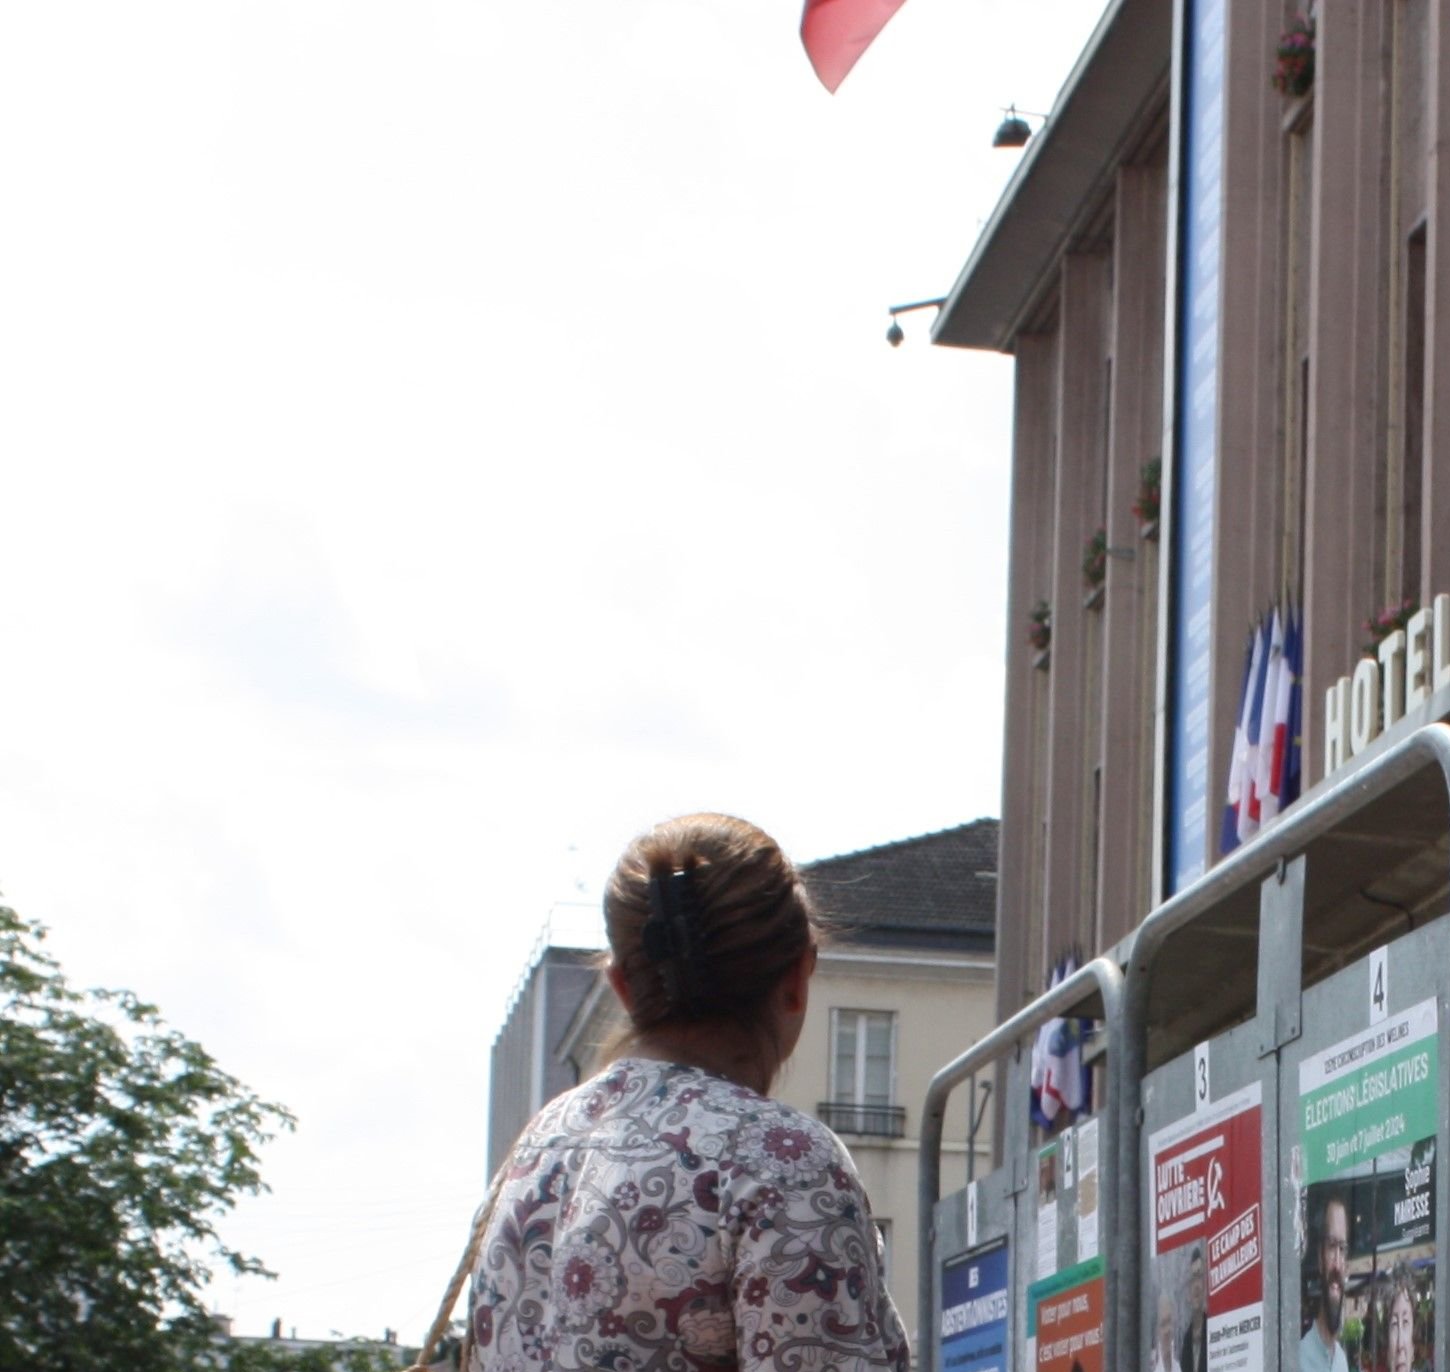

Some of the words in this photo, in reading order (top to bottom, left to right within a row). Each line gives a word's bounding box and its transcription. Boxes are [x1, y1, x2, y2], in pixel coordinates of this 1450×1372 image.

[1373, 961, 1384, 1012] 4
[1199, 1058, 1206, 1100] 3
[1305, 1085, 1354, 1131] ÉLECTIONS
[1356, 1052, 1429, 1107] LÉGISLATIVES
[1157, 1162, 1184, 1193] LUTTE
[1157, 1175, 1205, 1224] OUVRIÈRE
